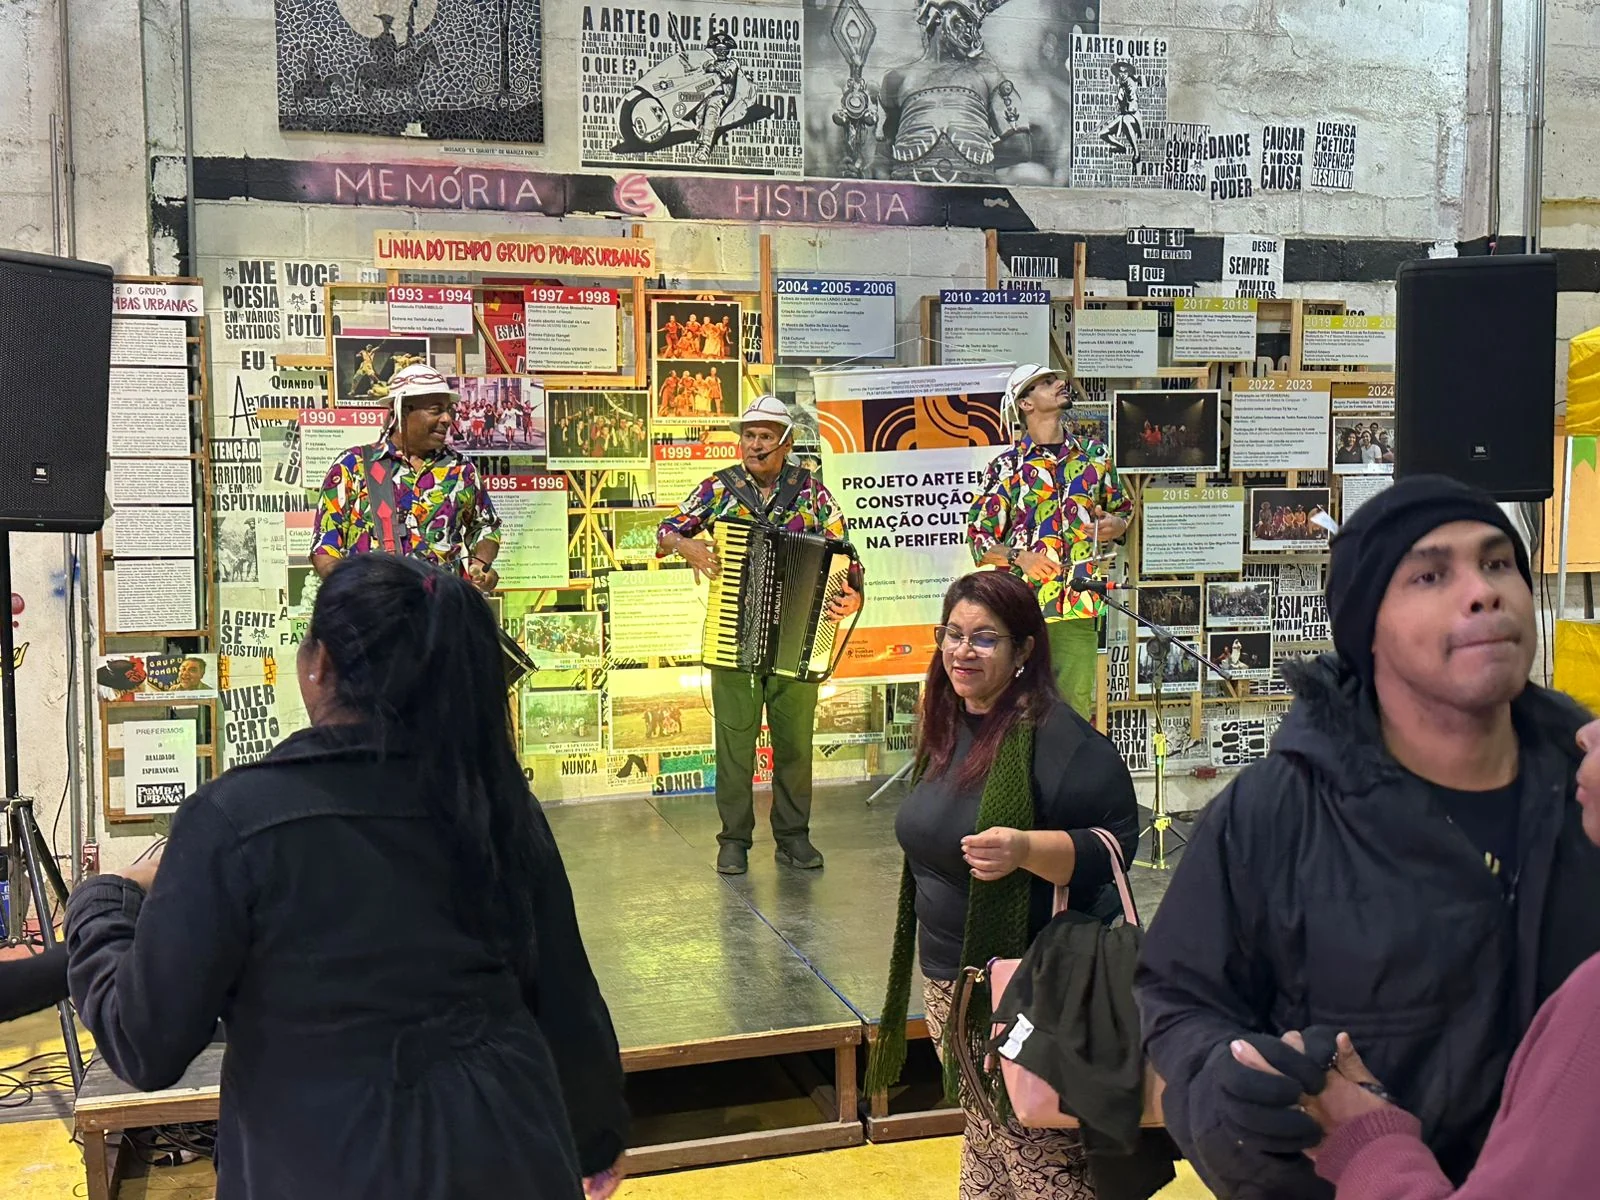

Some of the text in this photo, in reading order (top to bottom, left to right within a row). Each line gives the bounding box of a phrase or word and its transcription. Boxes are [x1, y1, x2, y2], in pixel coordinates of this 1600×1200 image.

[582, 6, 593, 31] A
[600, 7, 646, 34] ARTE
[649, 13, 660, 38] O
[668, 14, 701, 41] QUE
[743, 16, 799, 43] CANGAÇO
[1075, 37, 1167, 57] A ARTE O QUE É?
[582, 55, 637, 76] O QUE É?
[1083, 69, 1097, 81] QUE
[582, 95, 589, 112] O
[1317, 122, 1356, 138] LICENSA
[1208, 134, 1250, 159] DANCE
[1262, 126, 1305, 151] CAUSAR
[1315, 136, 1355, 154] POÉTICA
[1166, 141, 1208, 160] COMPRE
[1262, 151, 1303, 165] É NOSSA
[1166, 159, 1188, 173] SEU
[1214, 164, 1247, 180] QUANTO
[1164, 172, 1206, 191] INGRESSO
[1260, 165, 1302, 190] CAUSA
[335, 166, 542, 206] MEMÓRIA
[735, 182, 909, 221] HISTÓRIA
[1211, 178, 1252, 200] PUDER
[1128, 230, 1183, 245] O QUE EU
[378, 238, 650, 268] LINHA DO TEMPO GRUPO POMBAS URBANAS
[1252, 240, 1277, 252] DESDE
[239, 261, 276, 284] ME
[285, 262, 339, 286] VOCÊ
[1013, 257, 1057, 277] ANORMAL
[1145, 268, 1164, 280] QUE
[1229, 256, 1269, 276] SEMPRE
[139, 287, 166, 295] GRUPO
[778, 281, 894, 294] 2004 2005 2006
[1239, 280, 1275, 290] MUITO
[223, 285, 279, 308] POESIA
[388, 288, 472, 302] 1993 1994
[531, 289, 610, 303] 1997 1998
[944, 292, 1046, 303] 2010 2011 2012
[143, 299, 198, 312] URBANAS
[1184, 299, 1249, 310] 2017 2018
[225, 308, 280, 323] EM VÁRIOS
[1304, 318, 1331, 328] 2019
[1343, 318, 1368, 328] 2020
[225, 324, 280, 339] SENTIDOS
[241, 351, 265, 370] EU
[270, 376, 314, 389] QUANDO
[1248, 380, 1313, 390] 2022 2023
[1368, 386, 1394, 396] 2024
[300, 411, 384, 424] 1990 1991
[661, 446, 736, 459] 1999 2000
[229, 484, 242, 493] EM
[484, 477, 564, 489] 1995 1996
[842, 474, 918, 490] PROJETO
[922, 471, 964, 486] ARTE
[256, 491, 310, 512] AMAZÔNIA
[856, 489, 974, 510] CONSTRUÇÃO
[1162, 489, 1229, 501] 2015 2016
[866, 532, 968, 549] NA PERIFERI
[910, 576, 950, 585] Programação
[873, 594, 906, 602] Formações
[907, 592, 932, 601] técnicas
[222, 610, 276, 628] A GENTE
[221, 625, 243, 644] SE
[220, 644, 273, 658] ACOSTUMA
[150, 657, 183, 667] GRUPO
[220, 684, 275, 711] VIVER
[232, 706, 267, 721] TUDO
[136, 727, 184, 735] PREFERIMOS
[226, 717, 279, 743] CERTO
[236, 739, 274, 755] NADA
[1221, 722, 1240, 765] CAOS
[561, 759, 598, 776] NUNCA
[138, 785, 183, 795] POMBAS
[655, 771, 703, 793] SONHO
